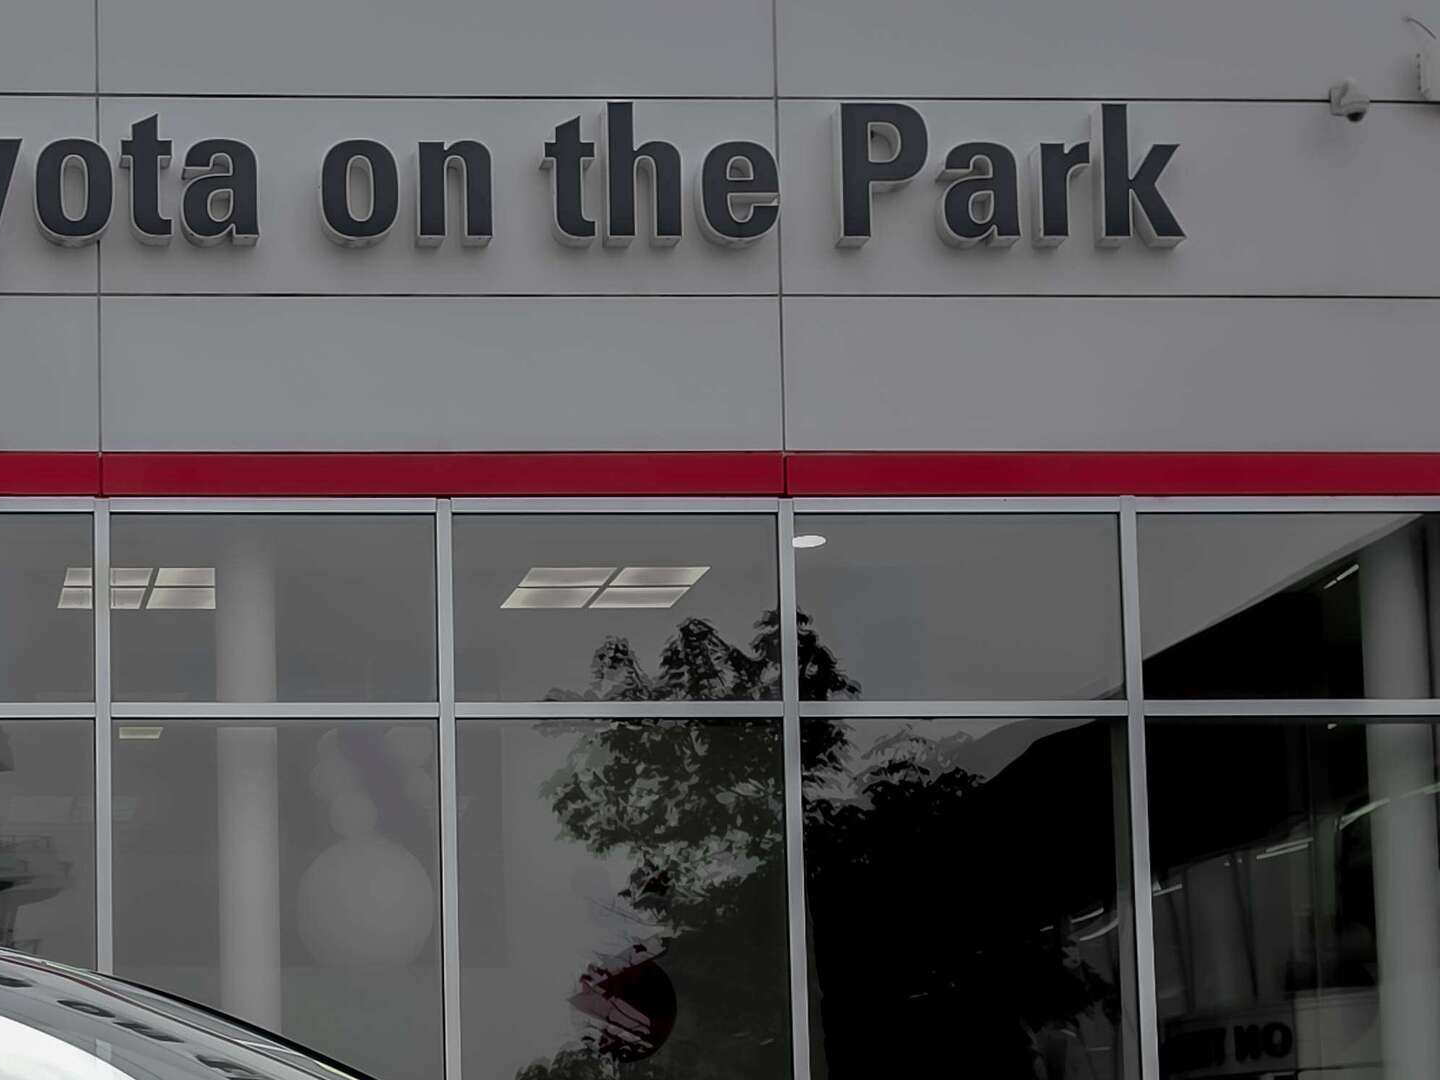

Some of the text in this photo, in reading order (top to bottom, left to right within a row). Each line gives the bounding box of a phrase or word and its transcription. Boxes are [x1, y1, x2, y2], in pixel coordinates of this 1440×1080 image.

[320, 137, 493, 246] on
[541, 101, 780, 247] the
[834, 102, 1187, 248] Park
